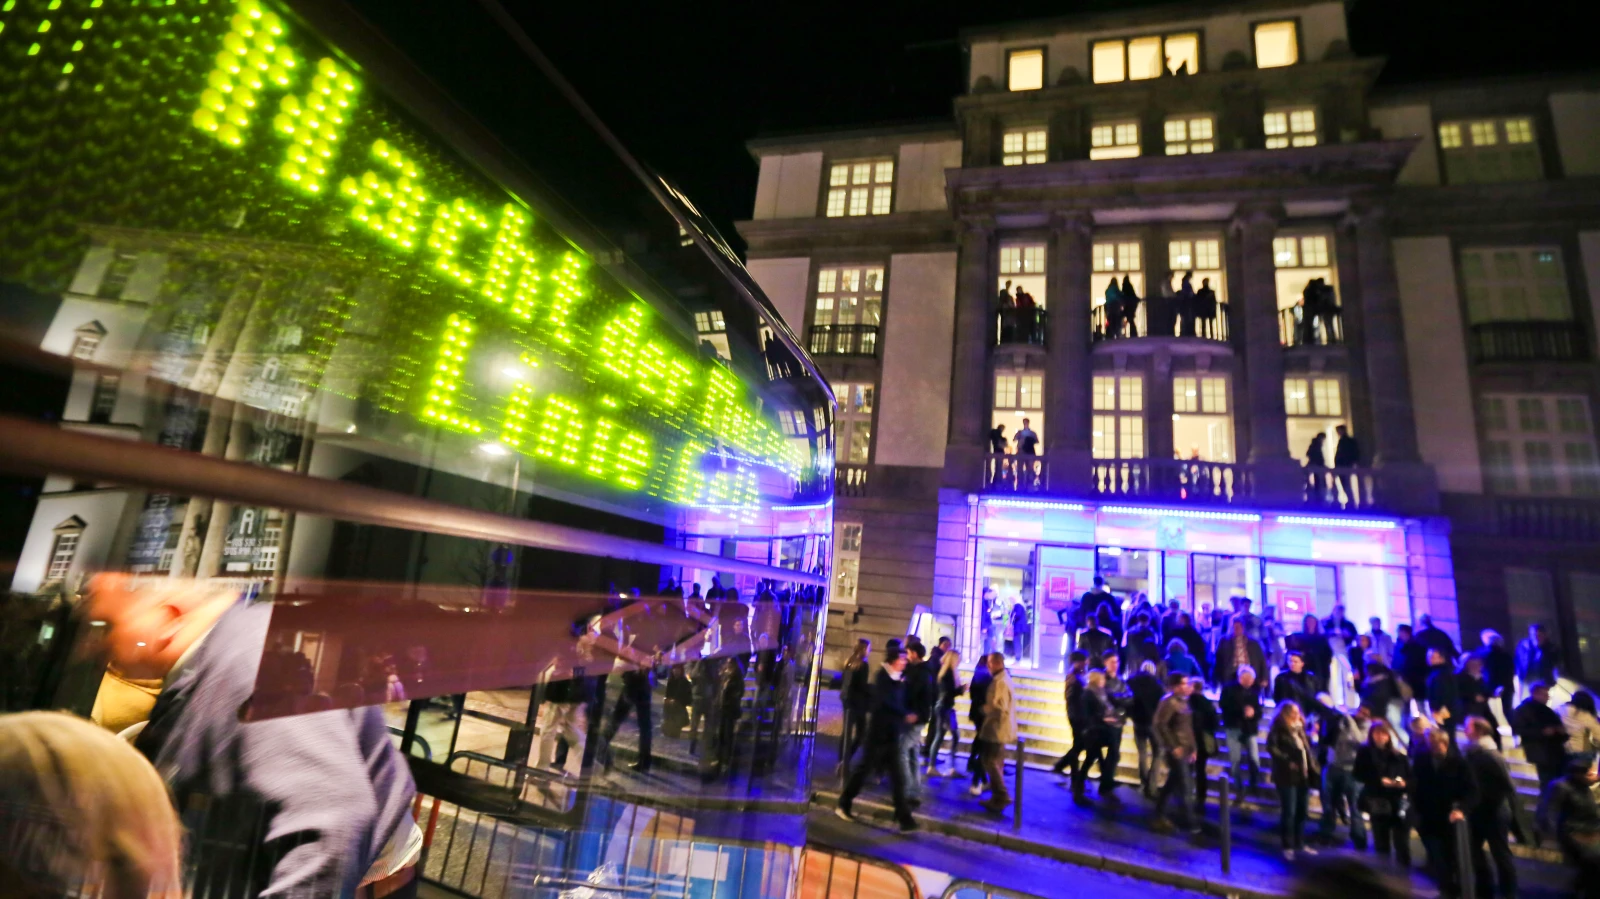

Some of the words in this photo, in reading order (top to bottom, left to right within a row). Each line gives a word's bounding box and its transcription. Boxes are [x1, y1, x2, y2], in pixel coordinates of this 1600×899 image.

[193, 0, 584, 344] Nacht
[599, 303, 693, 406] der
[422, 312, 649, 488] Linie
